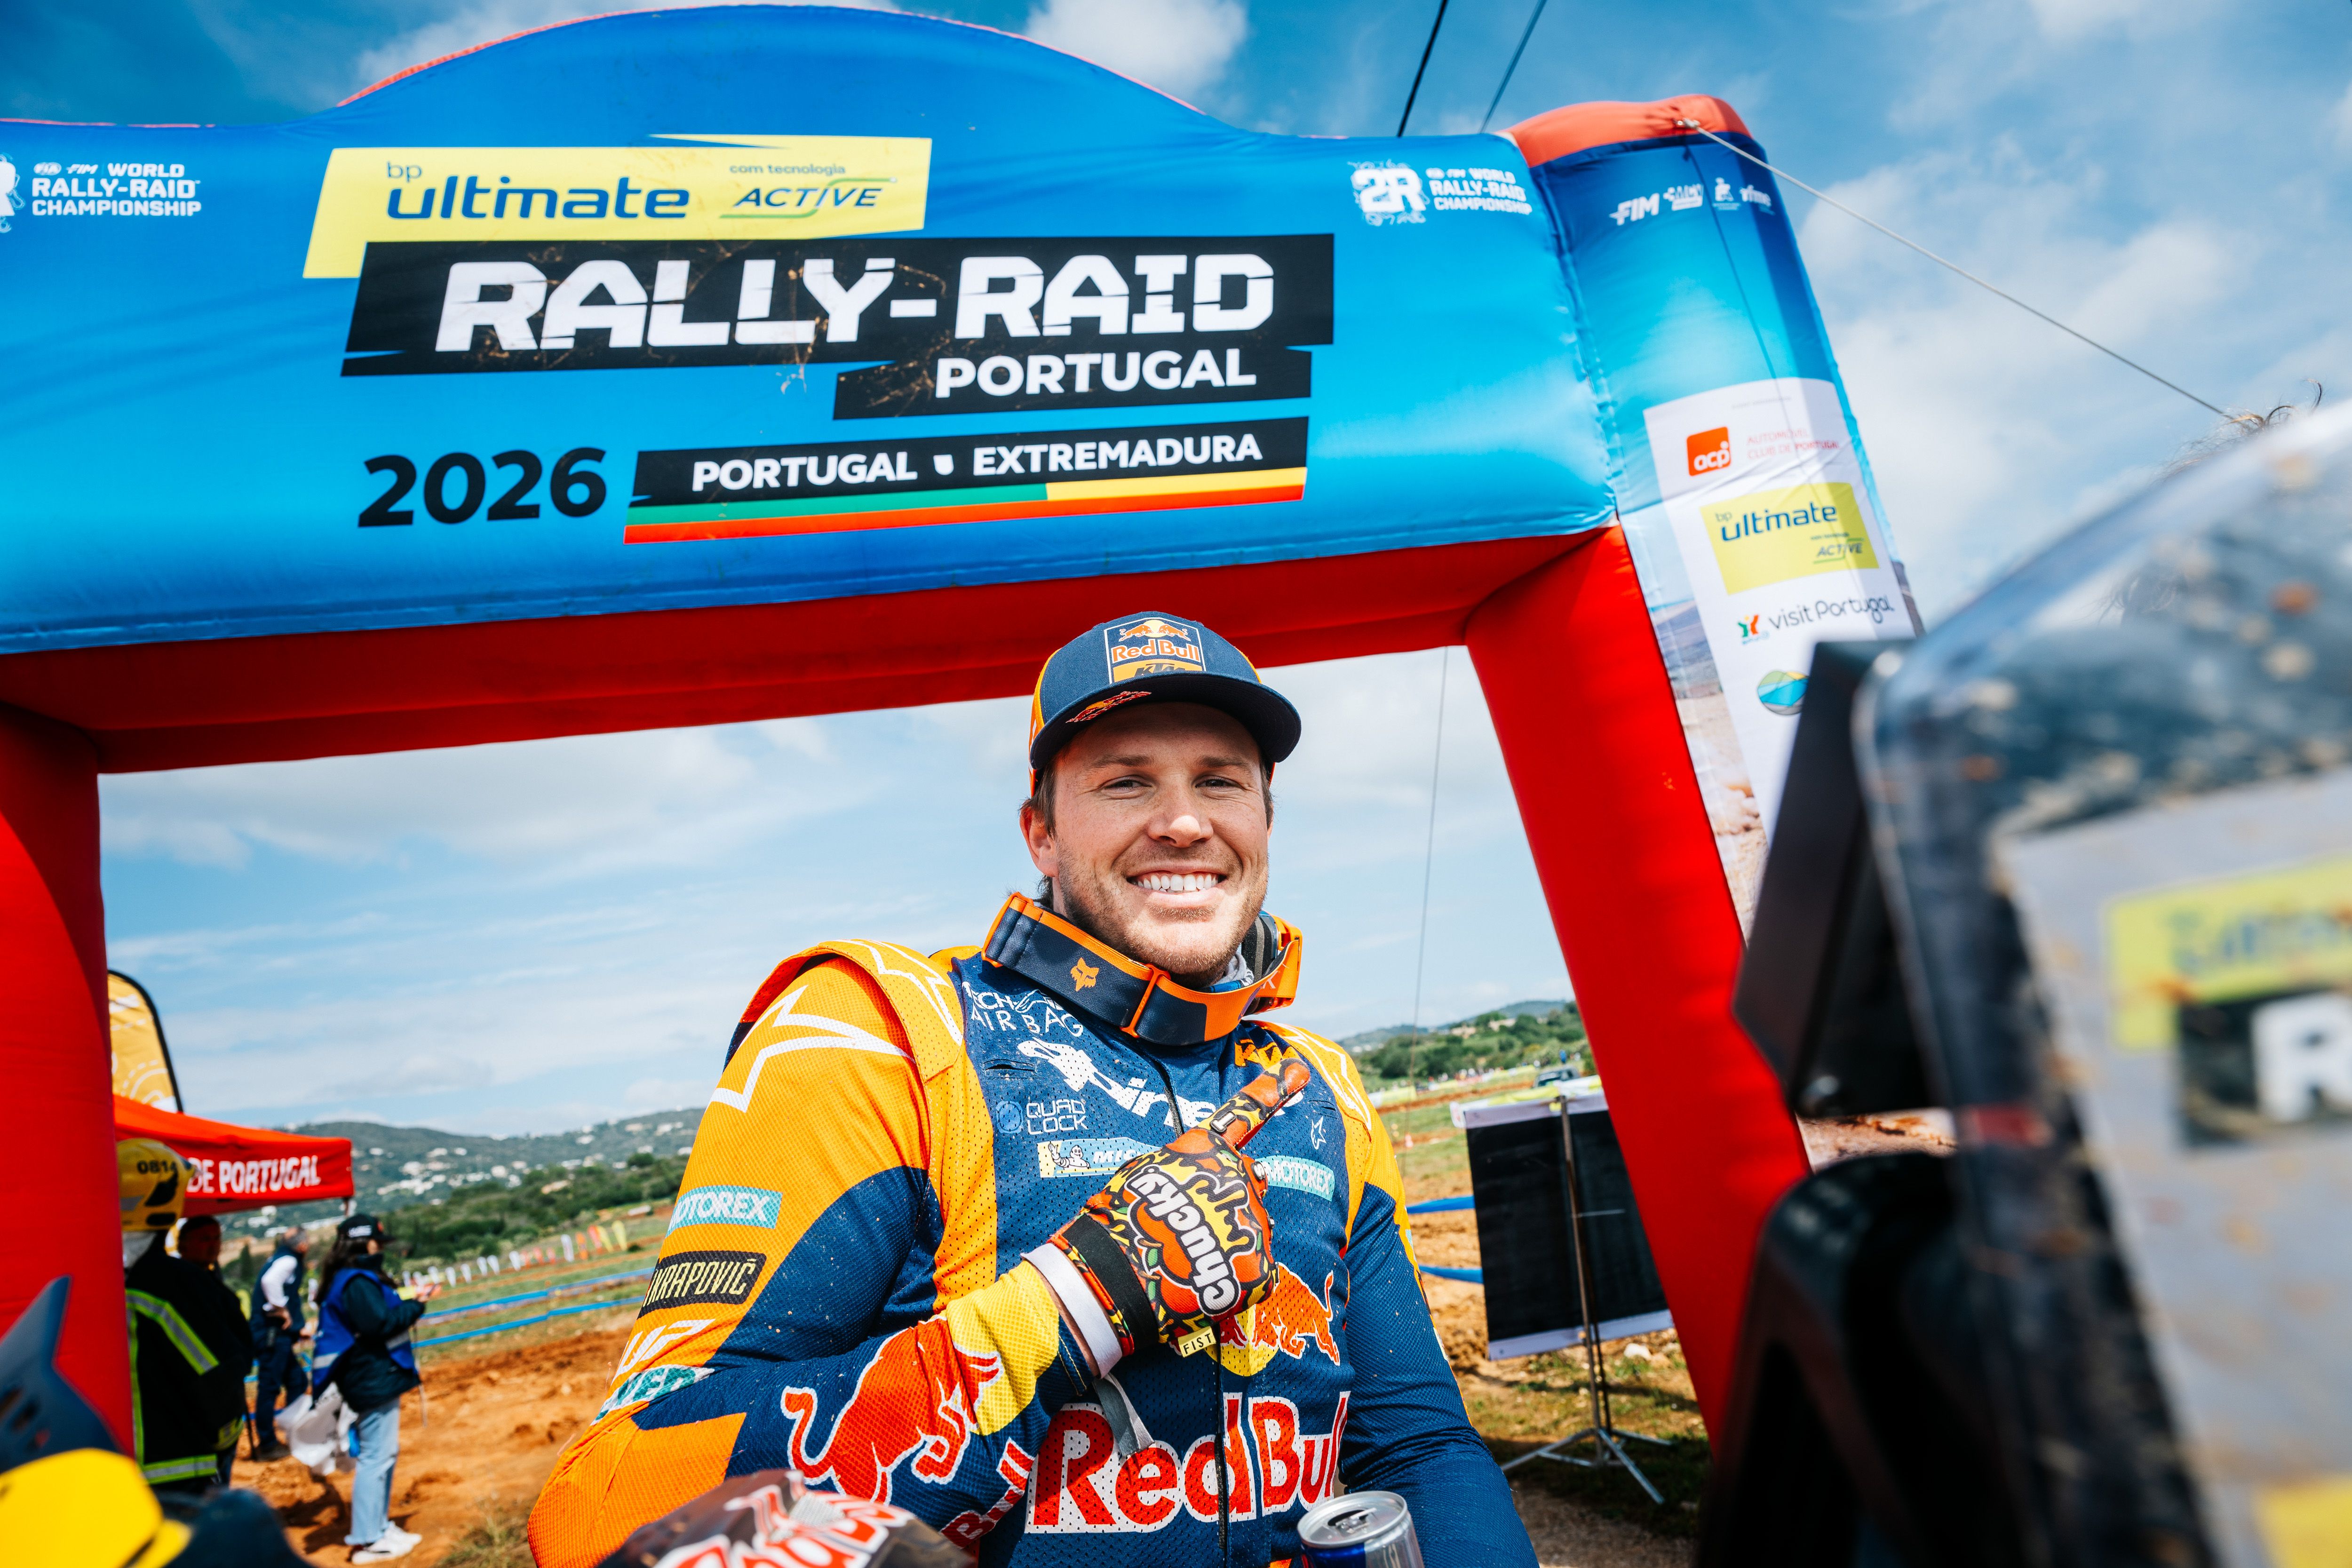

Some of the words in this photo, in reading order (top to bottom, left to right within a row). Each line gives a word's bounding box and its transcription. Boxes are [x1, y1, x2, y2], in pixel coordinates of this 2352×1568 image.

[107, 163, 184, 177] WORLD
[387, 161, 422, 182] bp
[730, 165, 763, 174] com
[768, 164, 846, 175] tecnologia
[1468, 167, 1516, 184] WORLD
[32, 178, 196, 198] RALLY-RAID
[388, 175, 690, 219] ultimate
[733, 188, 882, 207] ACTIVE
[1429, 180, 1527, 202] RALLY-RAID
[32, 200, 201, 216] CHAMPIONSHIP
[1434, 197, 1532, 215] CHAMPIONSHIP
[1609, 193, 1660, 225] FIM
[435, 254, 1273, 351] RALLY-RAID
[936, 348, 1256, 398] PORTUGAL
[692, 452, 917, 492] PORTUGAL
[973, 433, 1263, 476] EXTREMADURA
[358, 447, 607, 527] 2026
[1722, 501, 1837, 541] ultimate
[1111, 639, 1157, 663] Red
[1158, 639, 1201, 662] Bull
[1026, 1099, 1086, 1118] QUAD
[1027, 1115, 1089, 1135] LOCK
[186, 1157, 215, 1193] DE
[219, 1155, 321, 1194] PORTUGAL
[1262, 1160, 1332, 1195] MOTOREX
[1183, 1333, 1214, 1354] FIST
[1026, 1392, 1256, 1534] Red
